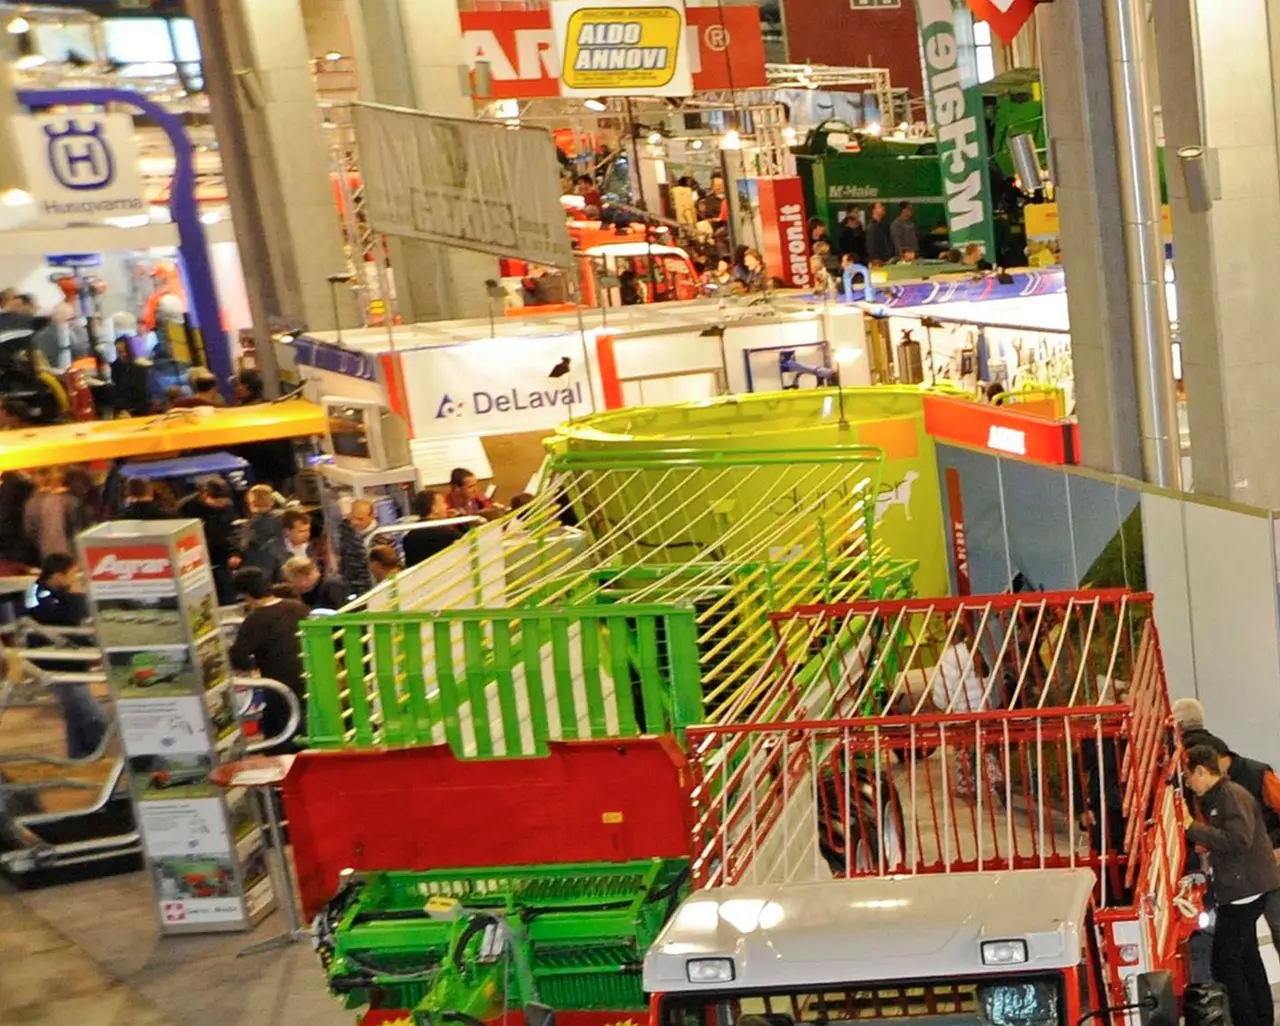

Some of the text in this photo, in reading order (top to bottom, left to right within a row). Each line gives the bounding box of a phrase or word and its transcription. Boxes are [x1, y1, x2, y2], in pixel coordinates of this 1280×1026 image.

[577, 22, 642, 46] ALDO
[573, 47, 668, 71] ANNOVI
[473, 381, 584, 416] DeLaval
[92, 553, 172, 581] Agrar
